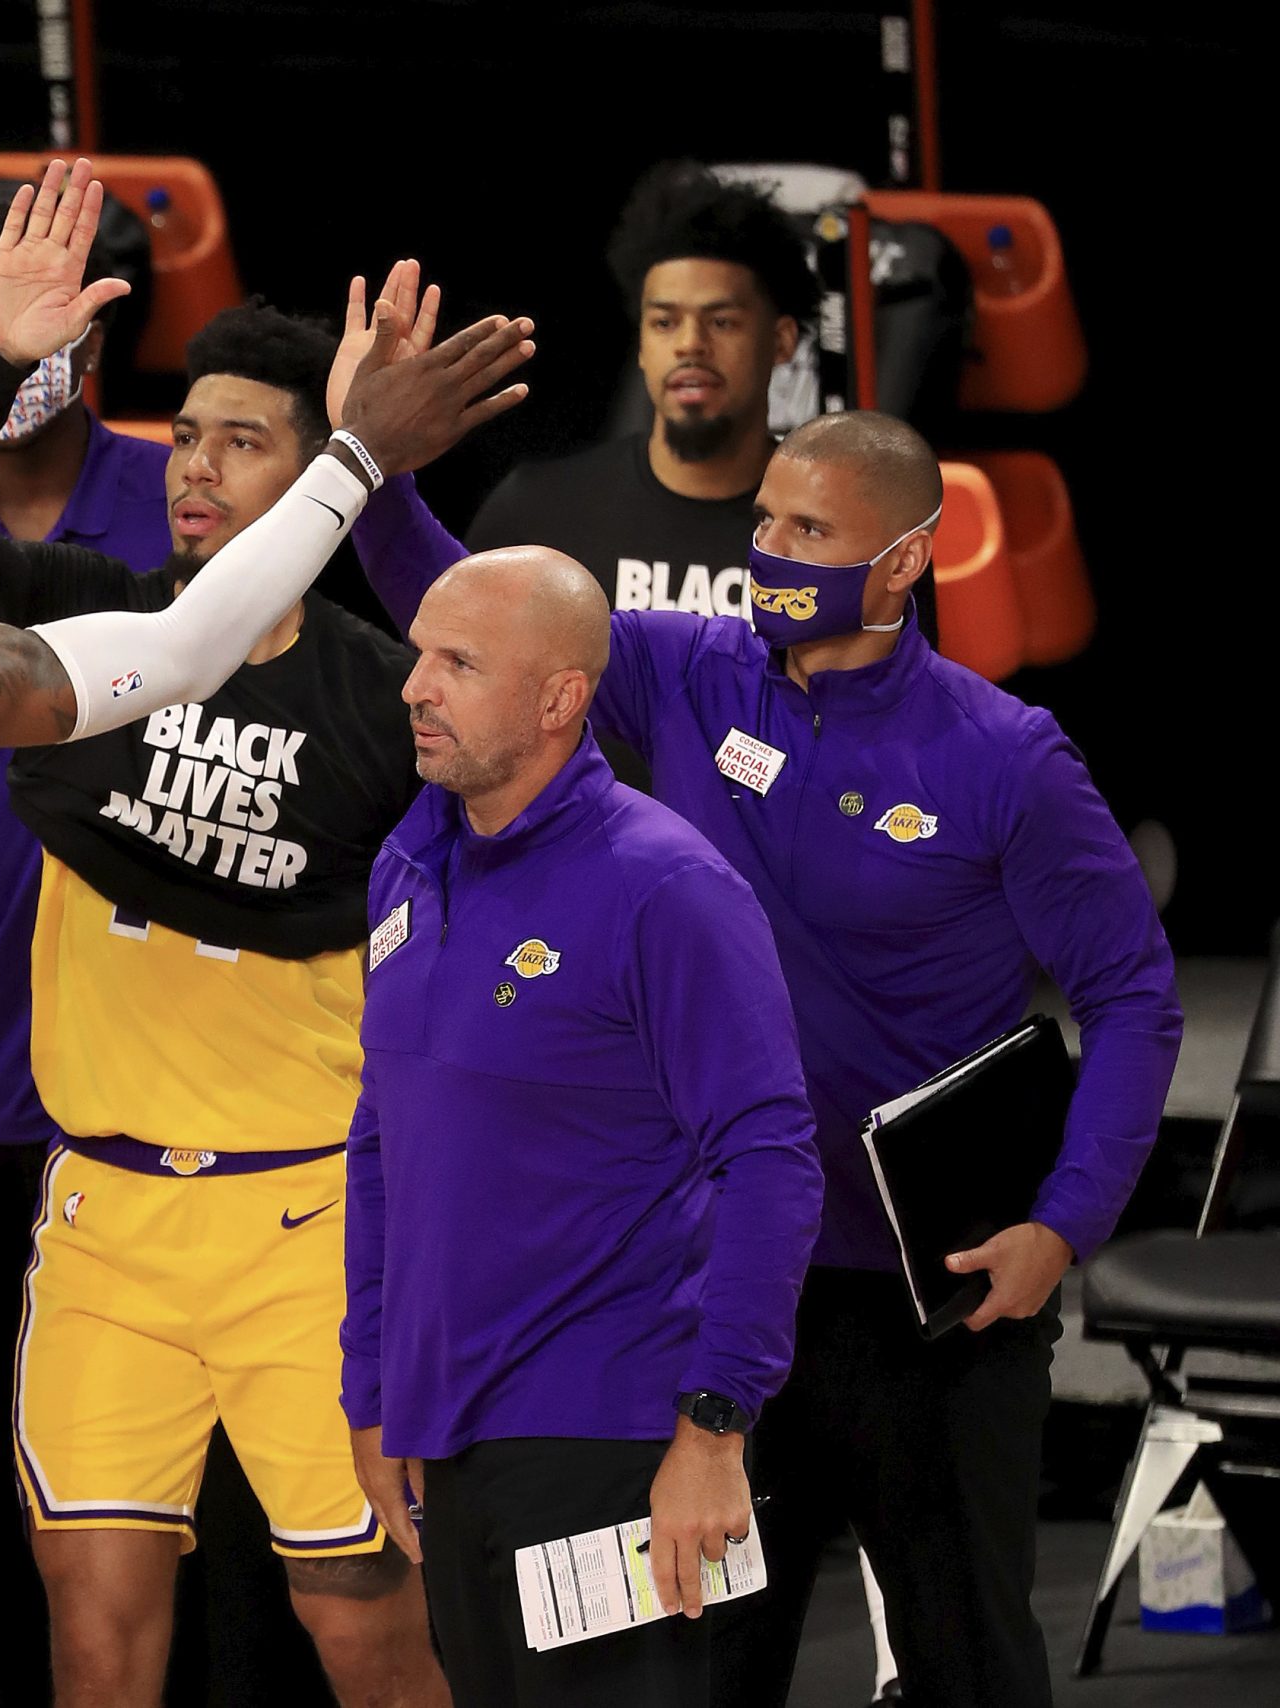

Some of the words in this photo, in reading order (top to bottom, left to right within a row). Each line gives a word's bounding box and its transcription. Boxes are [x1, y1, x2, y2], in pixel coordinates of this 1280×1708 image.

[350, 440, 381, 481] PROMISE
[143, 702, 307, 785] BLACK
[723, 745, 769, 776] RACIAL
[739, 736, 773, 756] COACHES
[142, 750, 282, 831] LIVES
[99, 790, 308, 889] MATTER
[370, 928, 406, 969] JUSTICE
[372, 920, 405, 954] RACIAL
[506, 945, 560, 973] LAKERS
